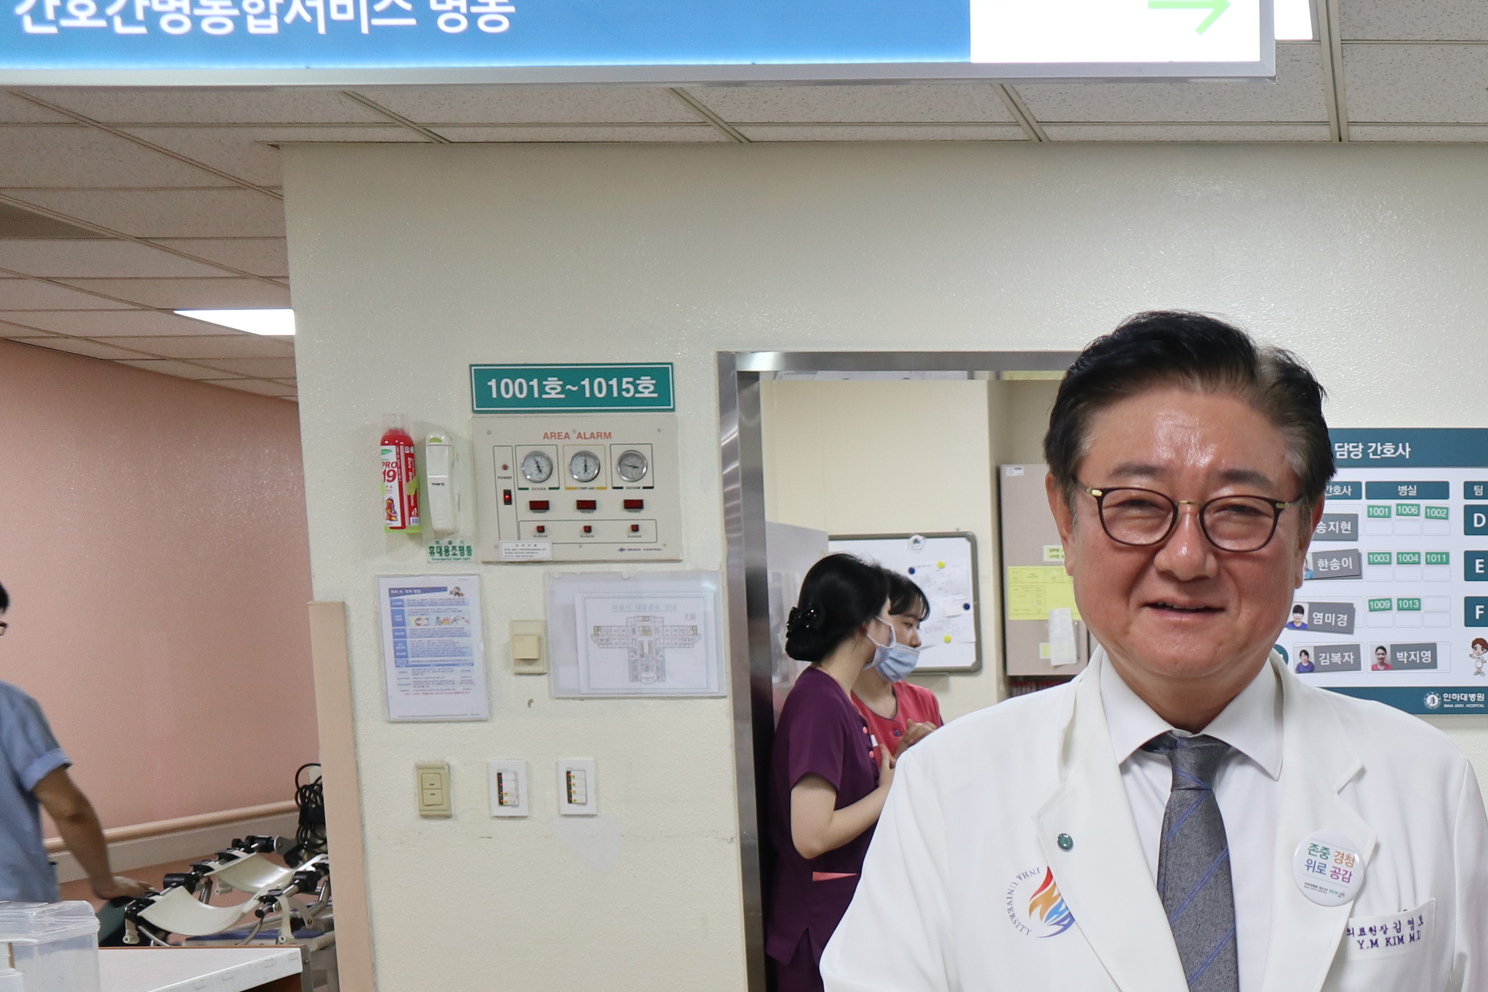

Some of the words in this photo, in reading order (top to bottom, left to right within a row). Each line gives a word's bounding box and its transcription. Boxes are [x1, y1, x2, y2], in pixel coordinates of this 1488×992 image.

[486, 375, 659, 399] 1001호~1015호
[542, 431, 571, 441] AREA
[576, 431, 612, 440] ALARM
[1334, 442, 1364, 459] 담당
[1367, 442, 1411, 459] 간호사
[1397, 485, 1418, 497] 병실
[1473, 485, 1484, 496] 팀
[1368, 507, 1389, 516] 1001
[1397, 505, 1418, 514] 1006
[1426, 507, 1447, 517] 1002
[1473, 512, 1487, 528] D
[1315, 520, 1352, 535] 송지현
[428, 545, 473, 557] 휴대용조명등
[1317, 556, 1353, 572] 한송이
[1368, 554, 1390, 563] 1003
[1398, 554, 1419, 563] 1004
[1426, 554, 1447, 562] 1011
[1474, 558, 1485, 574] E
[1369, 600, 1391, 609] 1009
[1398, 599, 1420, 609] 1013
[1474, 604, 1485, 619] F
[1312, 611, 1348, 627] 염미경
[1318, 651, 1355, 666] 김복자
[1396, 650, 1432, 664] 박지영
[1442, 692, 1485, 702] 인하대병원
[1307, 842, 1331, 860] 존중
[1333, 850, 1356, 868] 경청
[1016, 867, 1041, 881] INHA
[1304, 858, 1327, 875] 위로
[1329, 865, 1353, 884] 공감
[1385, 934, 1405, 947] KIM
